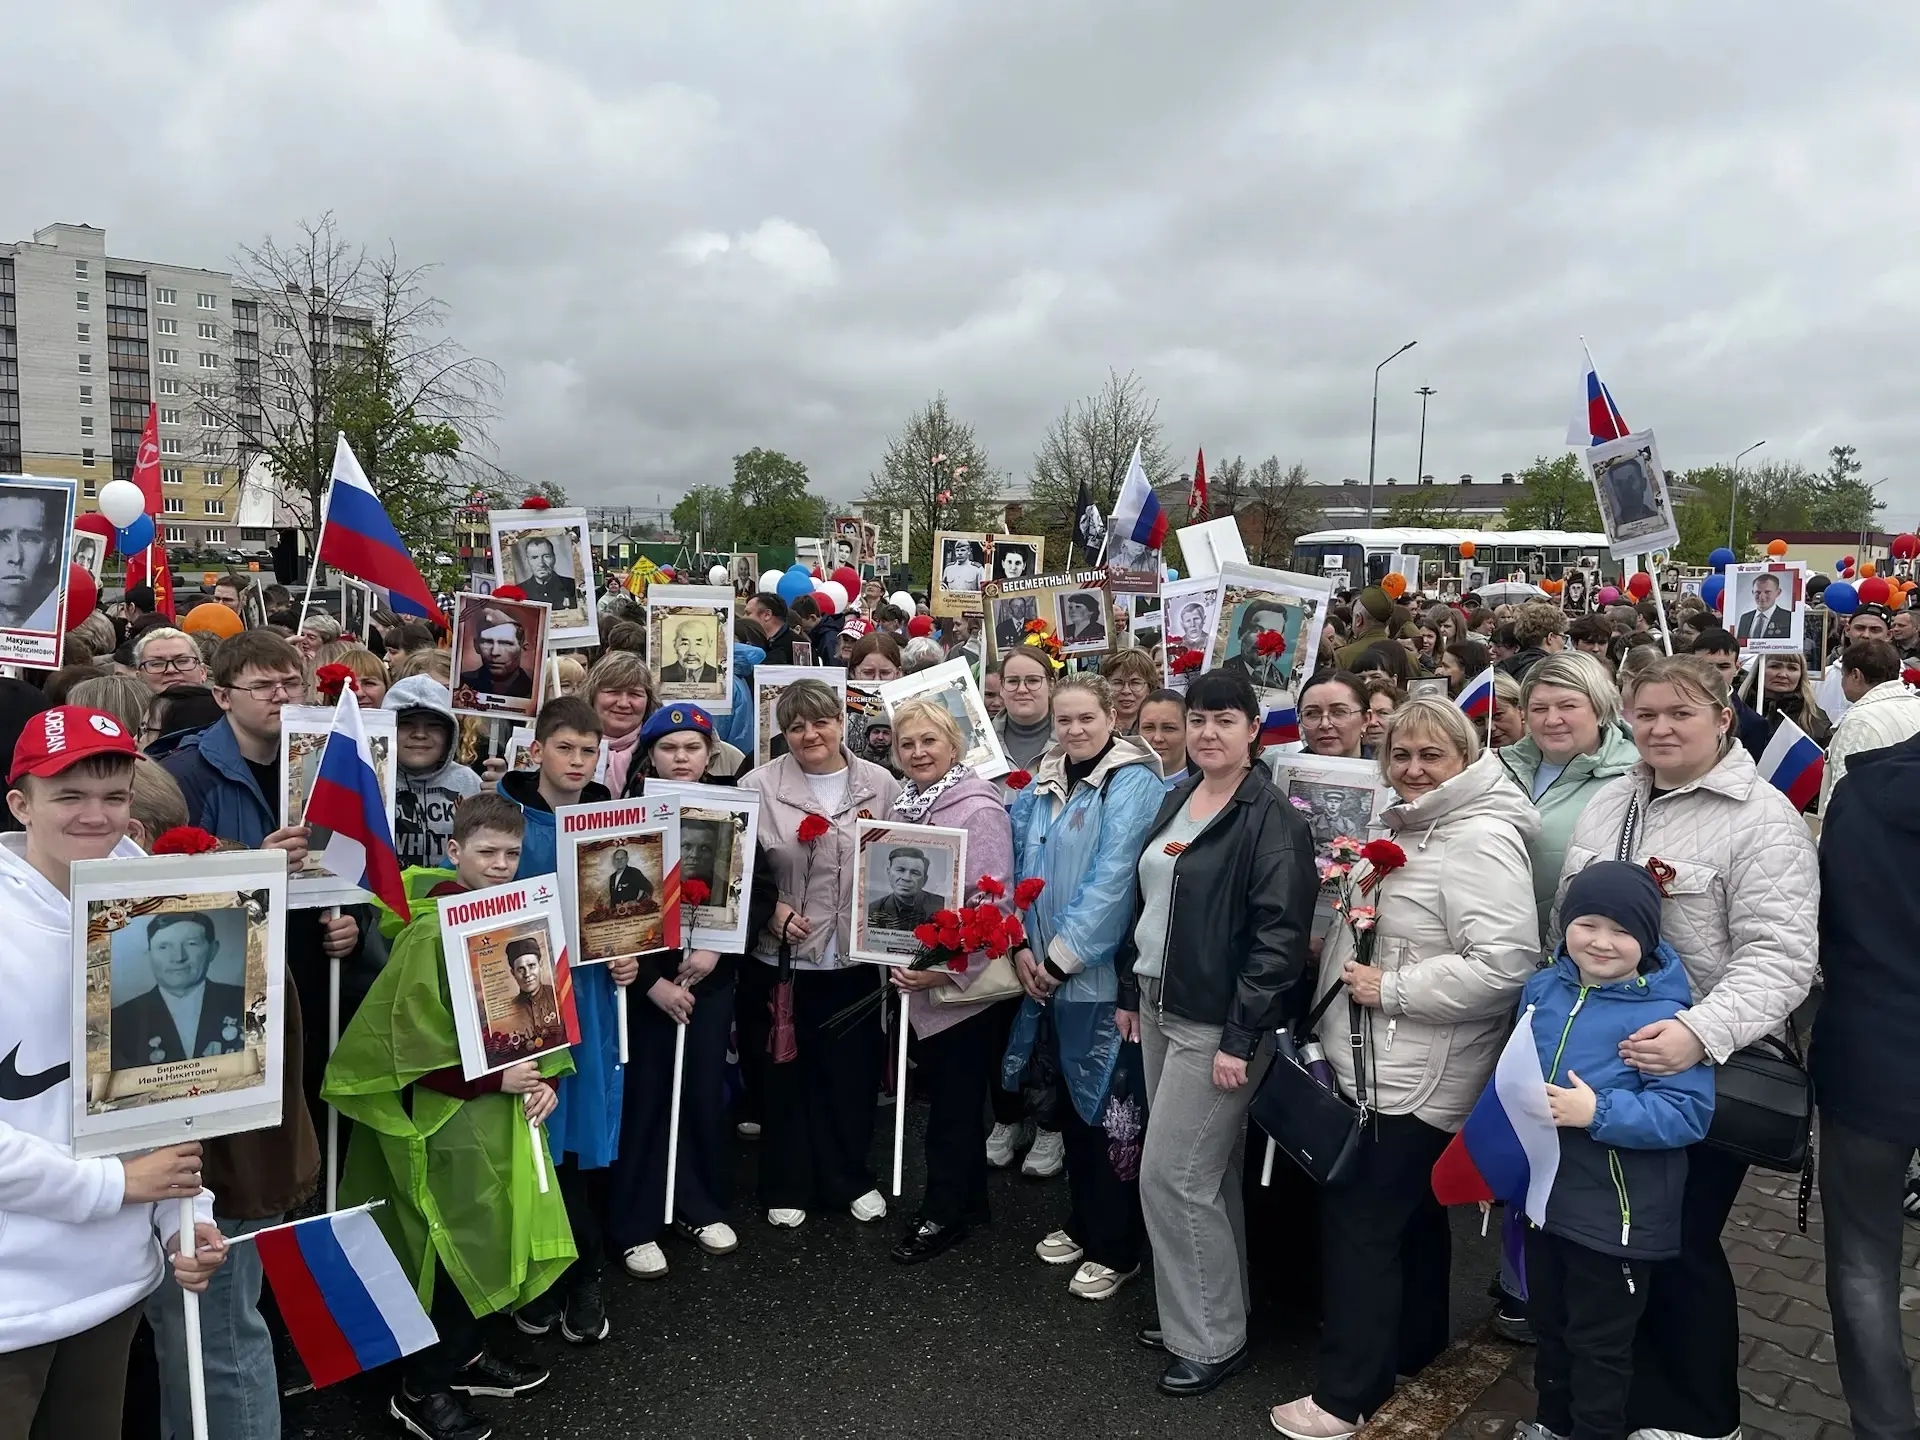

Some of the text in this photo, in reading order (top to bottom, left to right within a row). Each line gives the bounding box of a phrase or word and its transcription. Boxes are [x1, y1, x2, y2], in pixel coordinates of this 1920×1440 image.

[1002, 569, 1107, 593] БЕССМЕРТНЫЙ ПОЛК
[5, 636, 39, 646] Макушин
[13, 645, 55, 656] Максимович
[45, 710, 67, 754] JORDAN
[564, 806, 646, 833] ПОМНИМ!
[446, 890, 527, 927] ПОМНИМ!
[138, 1067, 218, 1085] Иван Никитович
[157, 1061, 201, 1074] Бирюков
